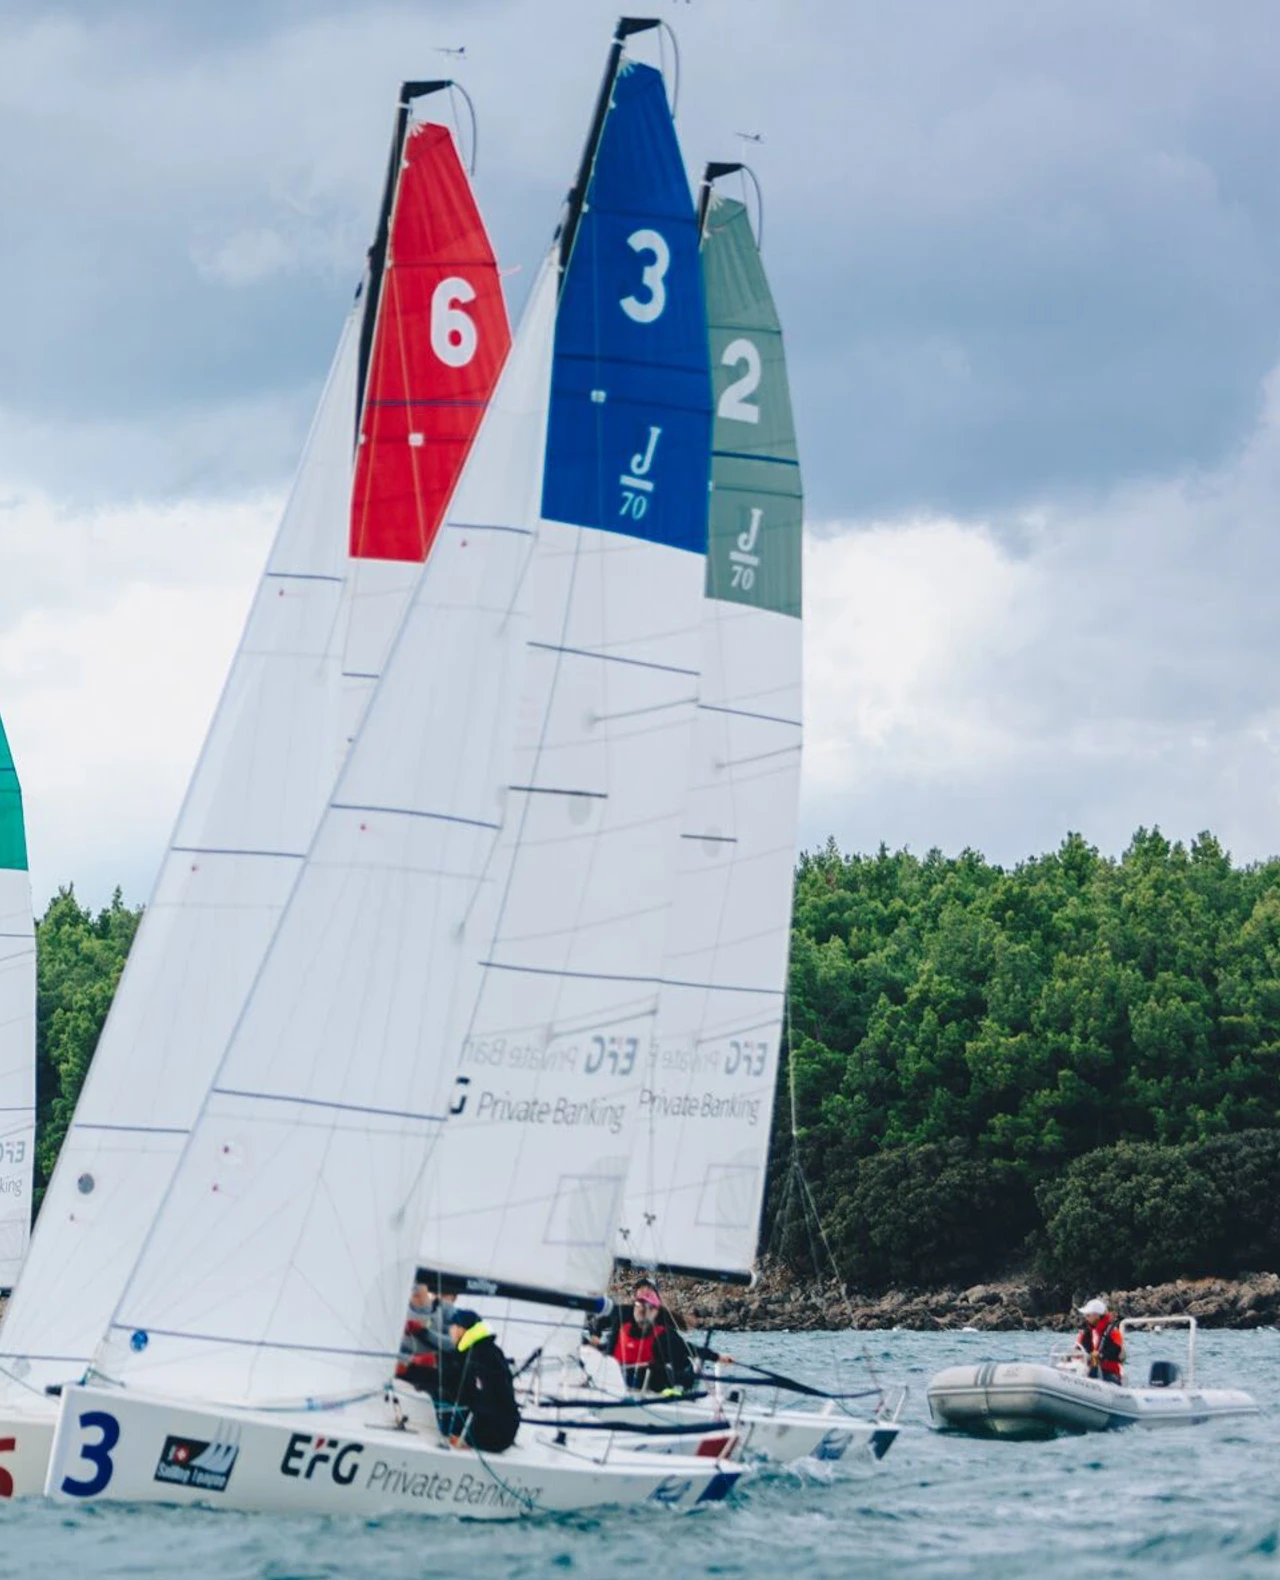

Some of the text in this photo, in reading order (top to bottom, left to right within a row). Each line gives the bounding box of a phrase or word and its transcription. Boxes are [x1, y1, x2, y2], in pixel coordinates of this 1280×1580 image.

[619, 228, 670, 323] 3
[430, 277, 477, 368] 6
[717, 338, 762, 425] 2
[630, 426, 662, 476] J
[620, 491, 647, 520] 70
[738, 508, 763, 554] J
[731, 565, 756, 591] 70
[477, 1091, 550, 1124] Private
[551, 1097, 625, 1134] Banking
[639, 1088, 698, 1117] Private
[61, 1411, 120, 1497] 3
[280, 1432, 544, 1508] EFG Private Banking
